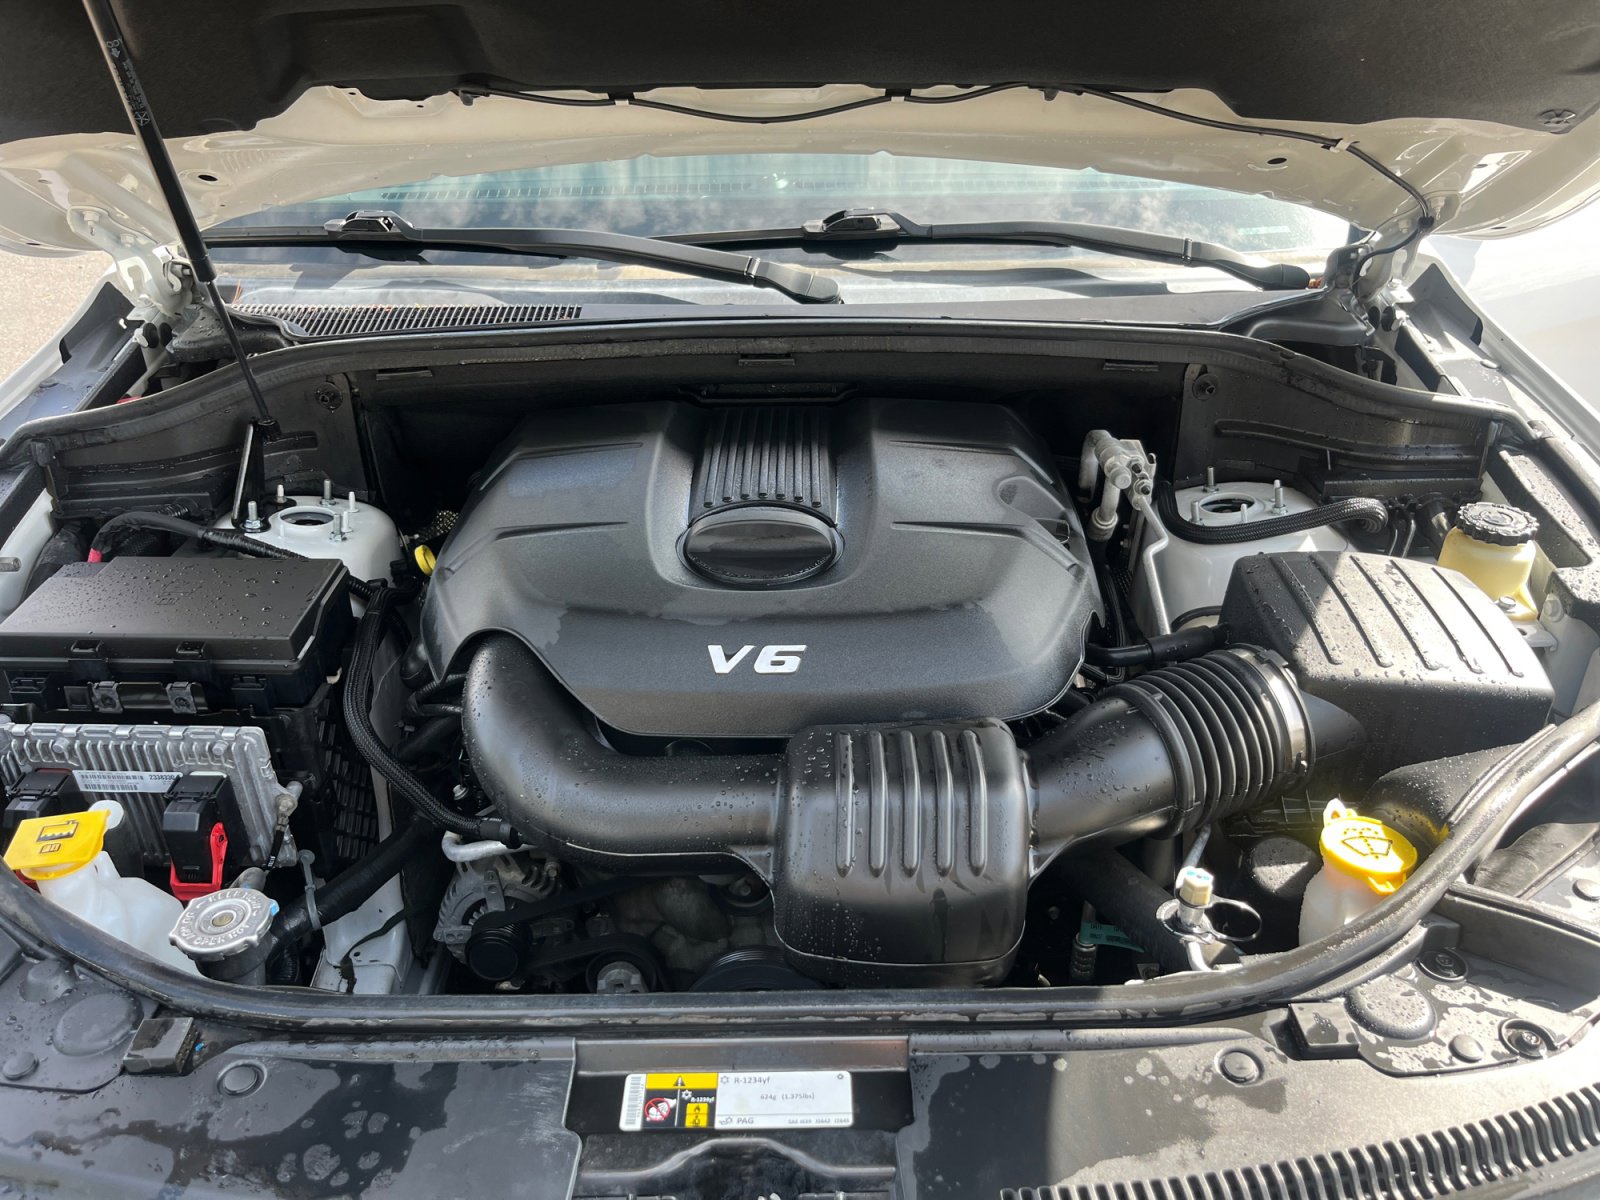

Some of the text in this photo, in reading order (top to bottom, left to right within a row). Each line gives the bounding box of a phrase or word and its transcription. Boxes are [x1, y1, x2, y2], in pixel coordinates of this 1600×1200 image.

[707, 644, 807, 674] V6
[193, 936, 225, 945] OPEN
[734, 1076, 770, 1085] R-1234yf
[737, 1117, 754, 1125] PAG
